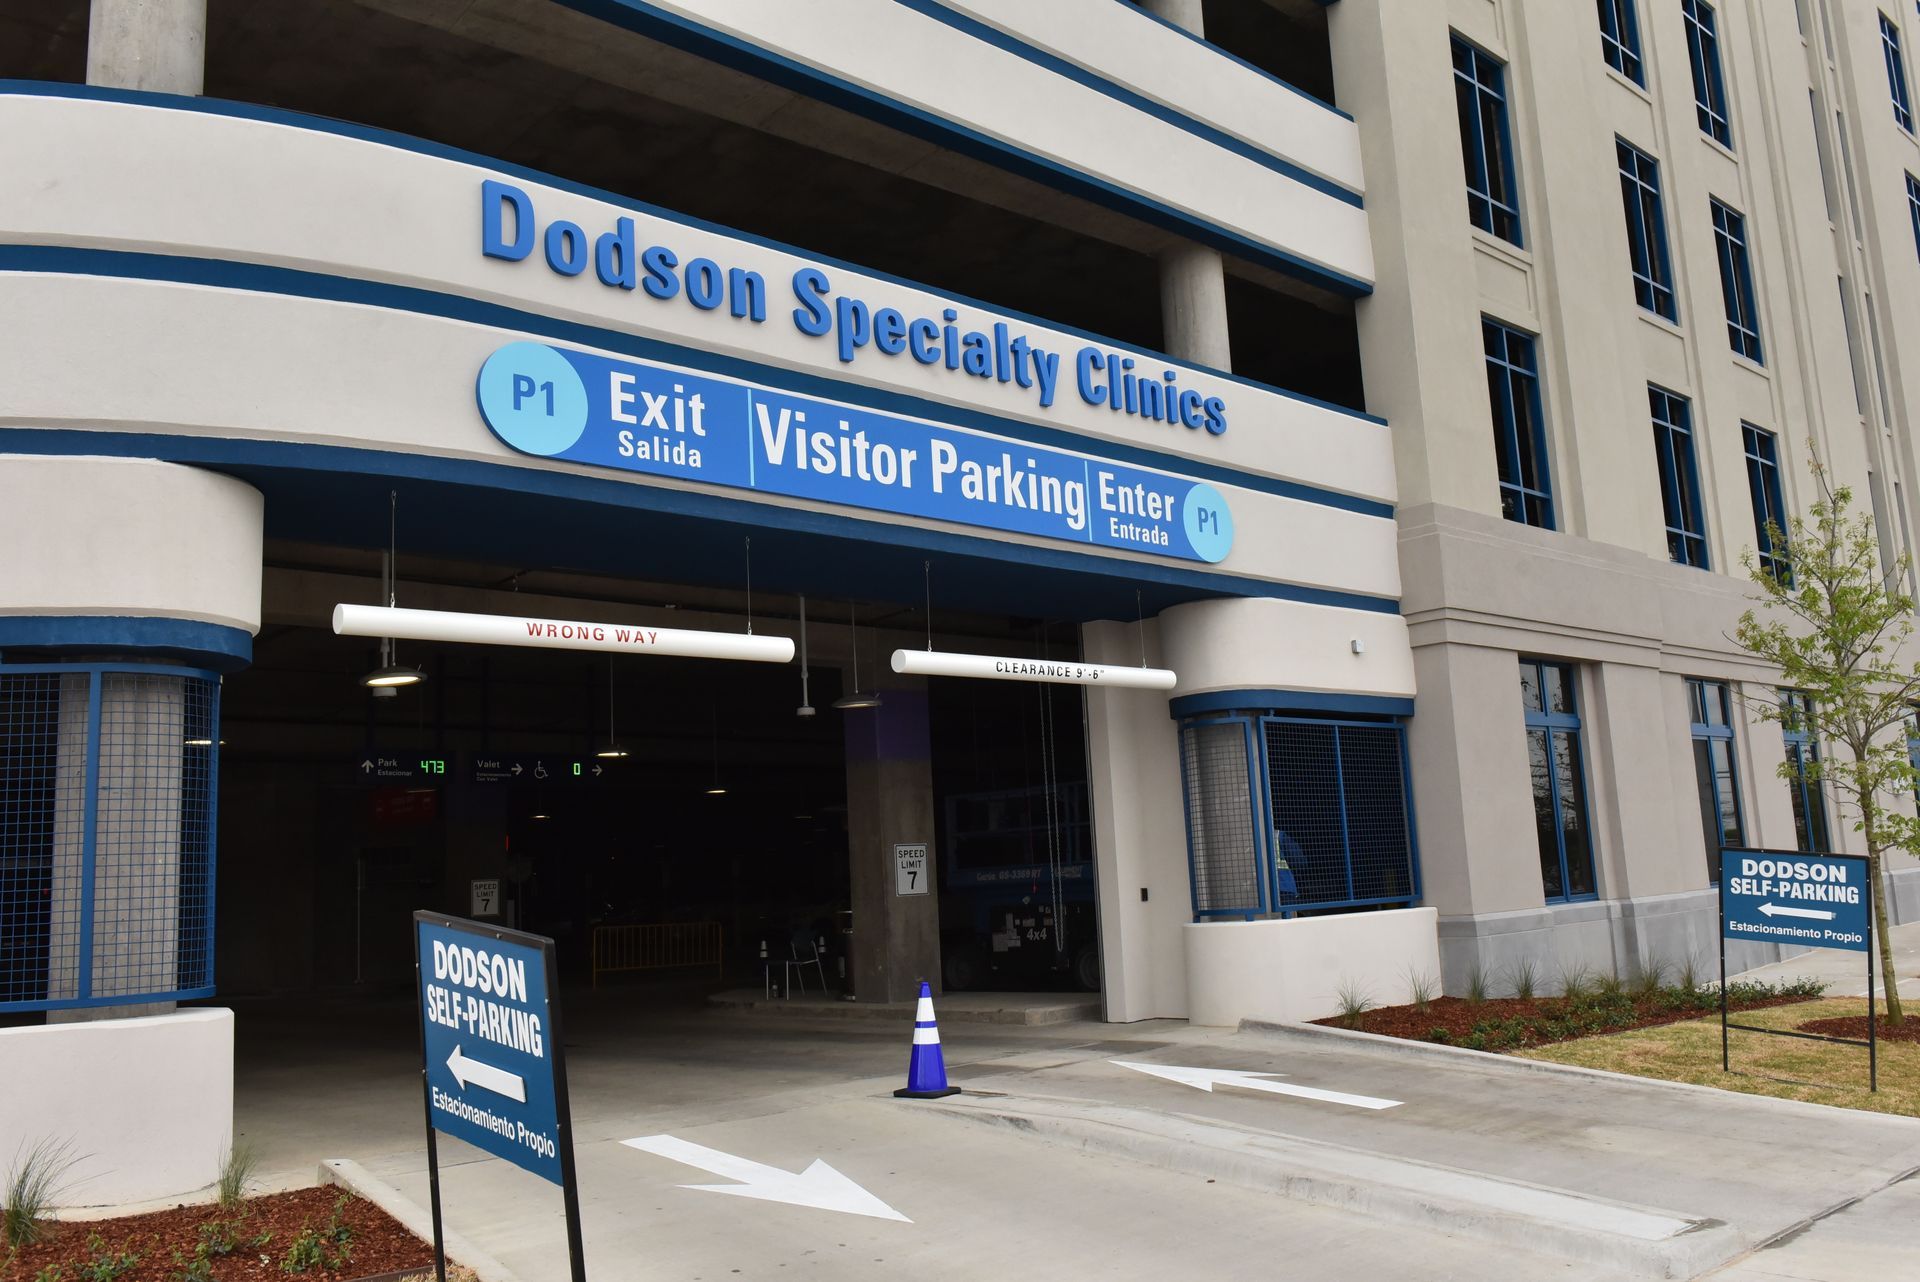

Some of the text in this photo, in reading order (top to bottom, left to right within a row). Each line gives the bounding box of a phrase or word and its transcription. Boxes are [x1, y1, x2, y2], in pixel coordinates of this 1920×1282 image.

[481, 179, 1228, 436] Dodson Specialty Clinics
[512, 373, 556, 417] P1
[609, 371, 706, 437] Exit
[618, 430, 702, 469] Salida
[755, 402, 1087, 531] Visitor Parking
[1098, 471, 1175, 522] Enter
[1109, 517, 1169, 547] Entrada
[1197, 507, 1219, 536] P1
[526, 622, 658, 645] WRONG WAY
[996, 661, 1072, 678] CLEARANCE
[377, 758, 397, 768] Park
[420, 760, 445, 774] 473
[476, 759, 501, 769] Valet
[898, 849, 925, 858] SPEED
[901, 860, 921, 869] LIMIT
[907, 870, 918, 890] 7
[1742, 858, 1847, 884] DODSON
[476, 890, 494, 898] LIMIT
[1730, 877, 1859, 905] SELF-PARKING
[481, 898, 490, 912] 7
[1026, 927, 1047, 941] 4x4
[1729, 920, 1863, 944] Estacionamiento Propio
[432, 940, 527, 1003] DODSON
[427, 983, 543, 1058] SELF-PARKING
[432, 1086, 556, 1159] Estacionamiento Propio
